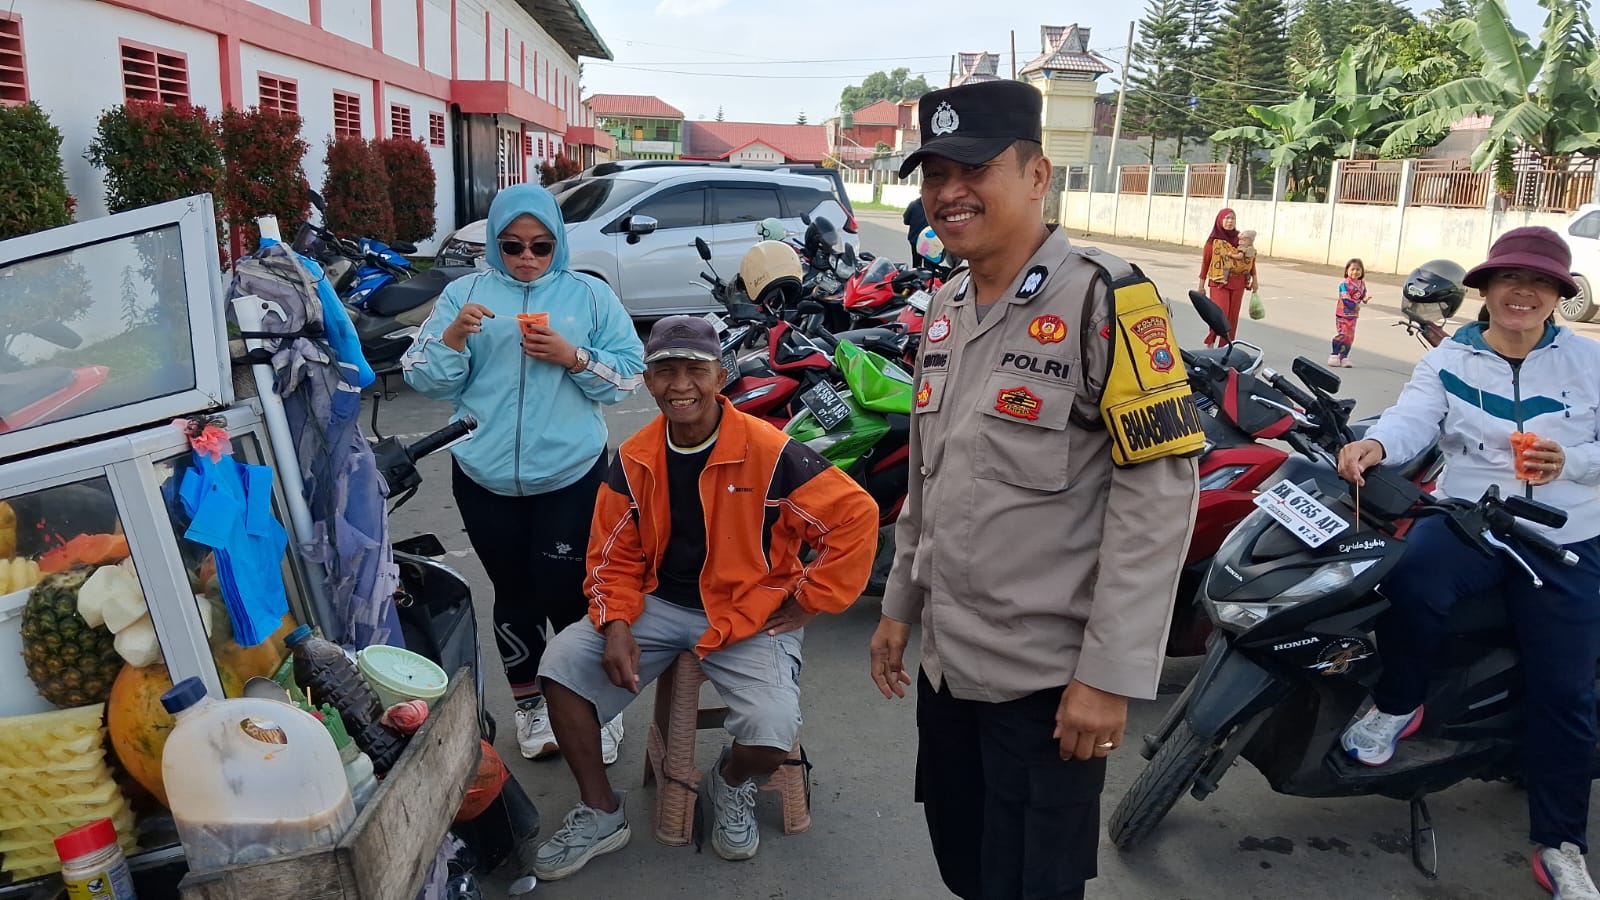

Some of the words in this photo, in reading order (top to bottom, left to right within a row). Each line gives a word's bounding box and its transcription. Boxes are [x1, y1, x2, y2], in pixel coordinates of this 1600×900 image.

[1001, 353, 1070, 379] POLRI
[1272, 484, 1295, 500] BK
[1289, 496, 1321, 519] 6755
[1315, 516, 1343, 535] AJX
[1298, 526, 1321, 543] 07.26
[1224, 564, 1243, 582] HONDA
[1273, 637, 1320, 651] HONDA
